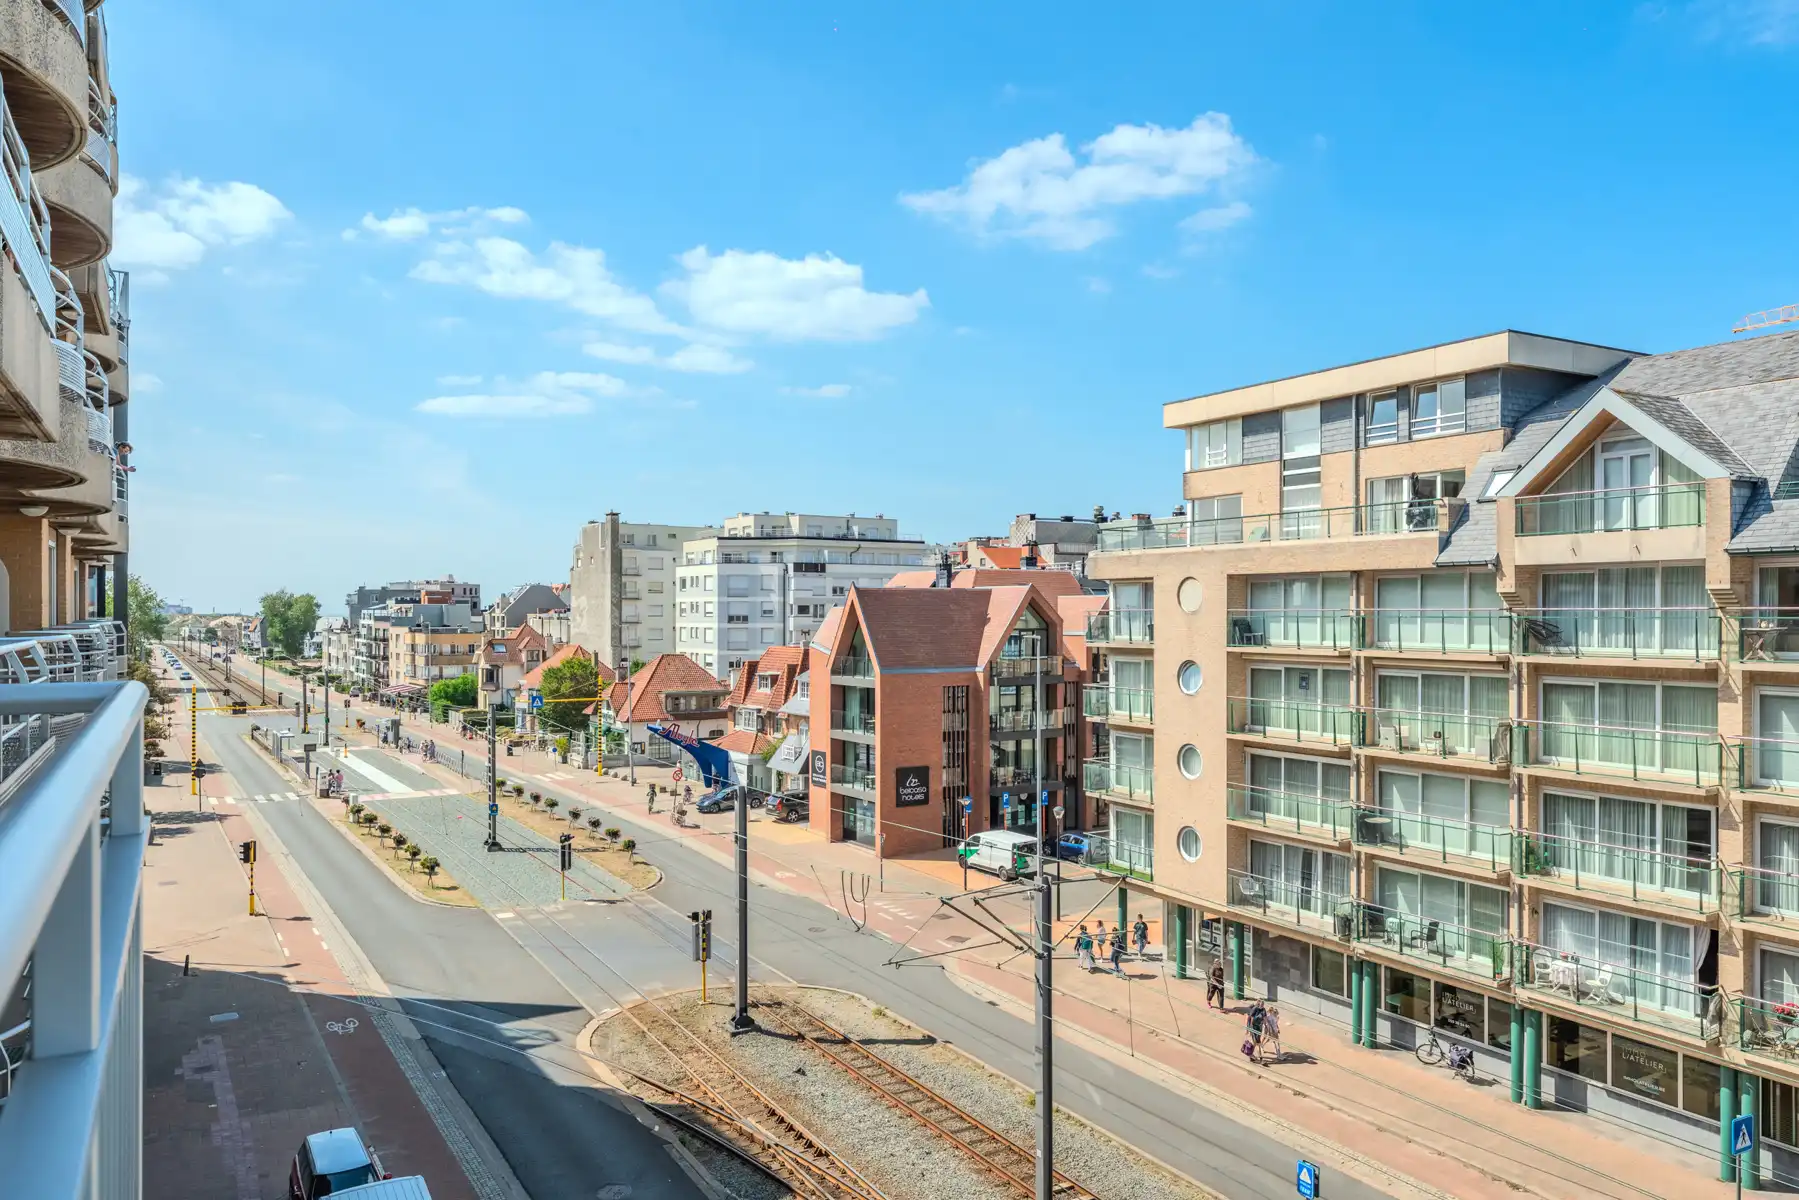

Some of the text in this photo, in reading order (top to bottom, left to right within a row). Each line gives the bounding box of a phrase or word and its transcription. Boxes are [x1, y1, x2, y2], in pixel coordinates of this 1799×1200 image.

[901, 793, 925, 801] hotels
[1003, 793, 1009, 803] P
[1042, 791, 1048, 801] P
